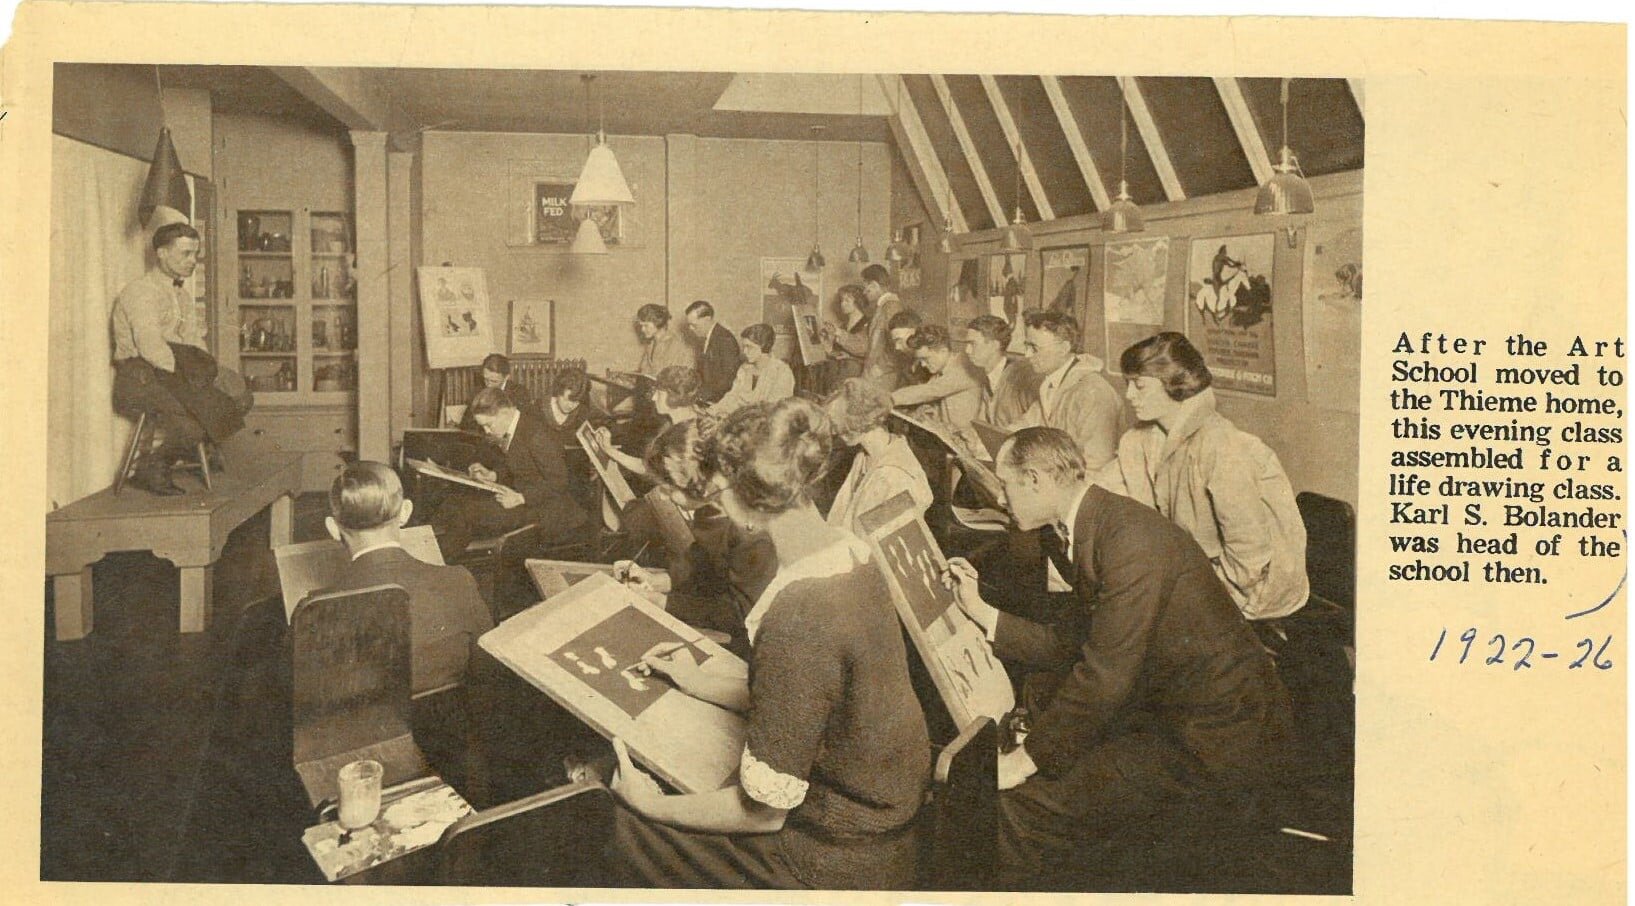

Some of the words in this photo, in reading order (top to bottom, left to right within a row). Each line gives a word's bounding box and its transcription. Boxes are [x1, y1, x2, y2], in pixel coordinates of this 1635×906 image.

[542, 197, 567, 207] MILK
[543, 207, 564, 217] FED
[1392, 331, 1487, 355] After
[1505, 334, 1548, 357] the
[1567, 335, 1625, 358] Art
[1391, 360, 1477, 383] School
[1496, 364, 1580, 386] moved
[1597, 365, 1624, 387] to
[1390, 388, 1433, 411] the
[1440, 388, 1538, 413] Thieme
[1546, 391, 1624, 419] home,
[1391, 416, 1442, 440] this
[1450, 418, 1552, 447] evening
[1561, 421, 1624, 444] class
[1391, 447, 1524, 470] assembled
[1539, 447, 1591, 472] for
[1606, 455, 1623, 473] a
[1389, 473, 1431, 496] life
[1438, 475, 1546, 504] drawing
[1552, 481, 1621, 501] class.
[1390, 501, 1449, 525] Karl
[1464, 503, 1488, 526] S.
[1504, 505, 1622, 529] Bolander
[1389, 536, 1440, 554] was
[1456, 532, 1518, 556] head
[1535, 533, 1563, 557] of
[1578, 535, 1621, 559] the
[1389, 560, 1470, 582] school
[1483, 561, 1549, 585] then.
[1429, 627, 1613, 671] 1922-26
